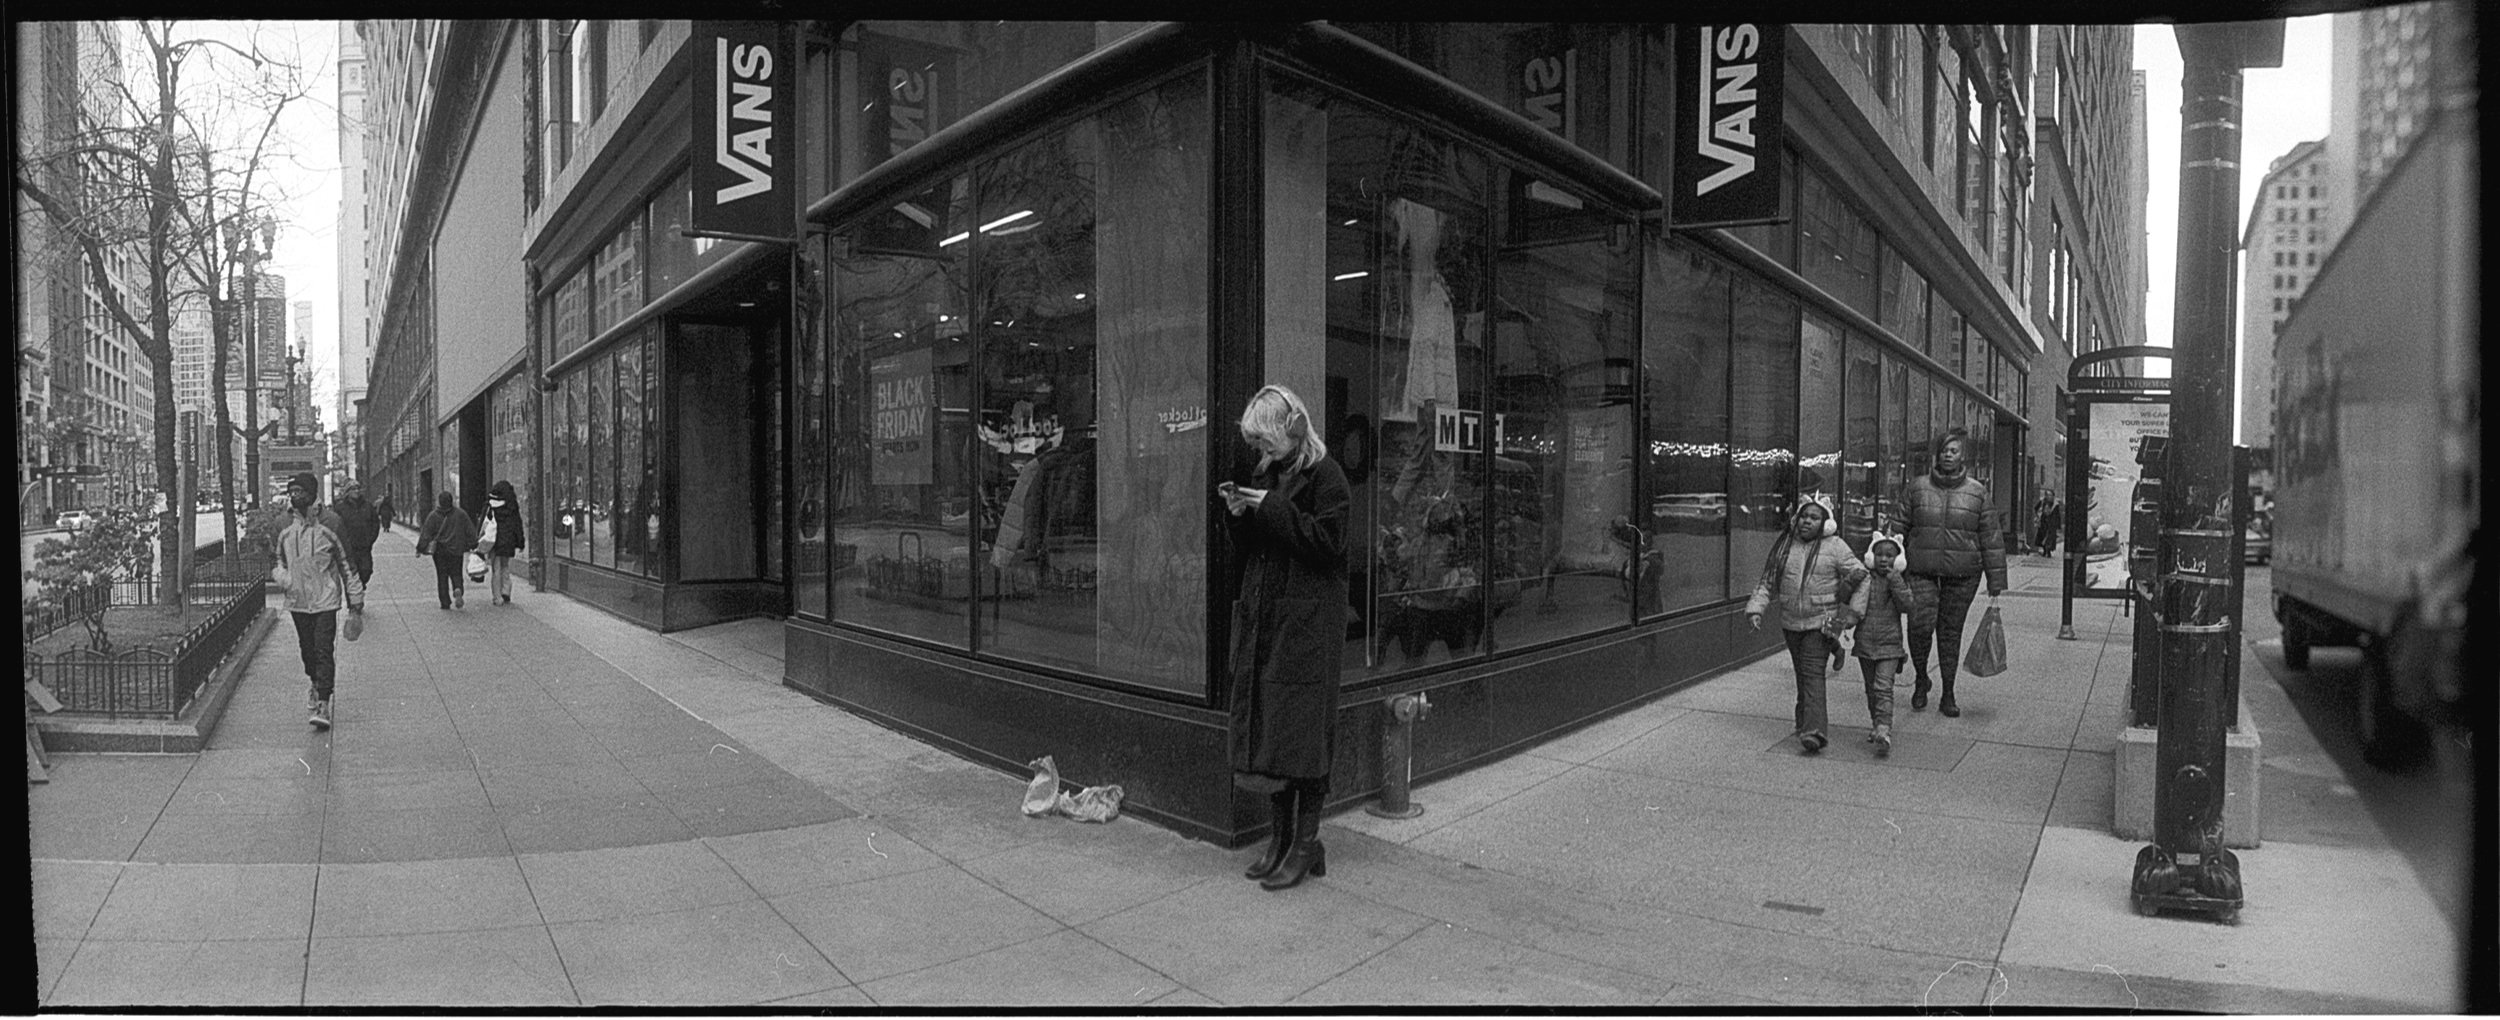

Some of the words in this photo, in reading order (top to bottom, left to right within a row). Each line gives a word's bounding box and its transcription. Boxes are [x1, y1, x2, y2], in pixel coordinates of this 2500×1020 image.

[716, 37, 773, 205] VANS
[1696, 24, 1759, 197] VANS
[878, 376, 924, 409] BLACK
[2101, 380, 2120, 388] CITY
[877, 406, 926, 439] FRIDAY
